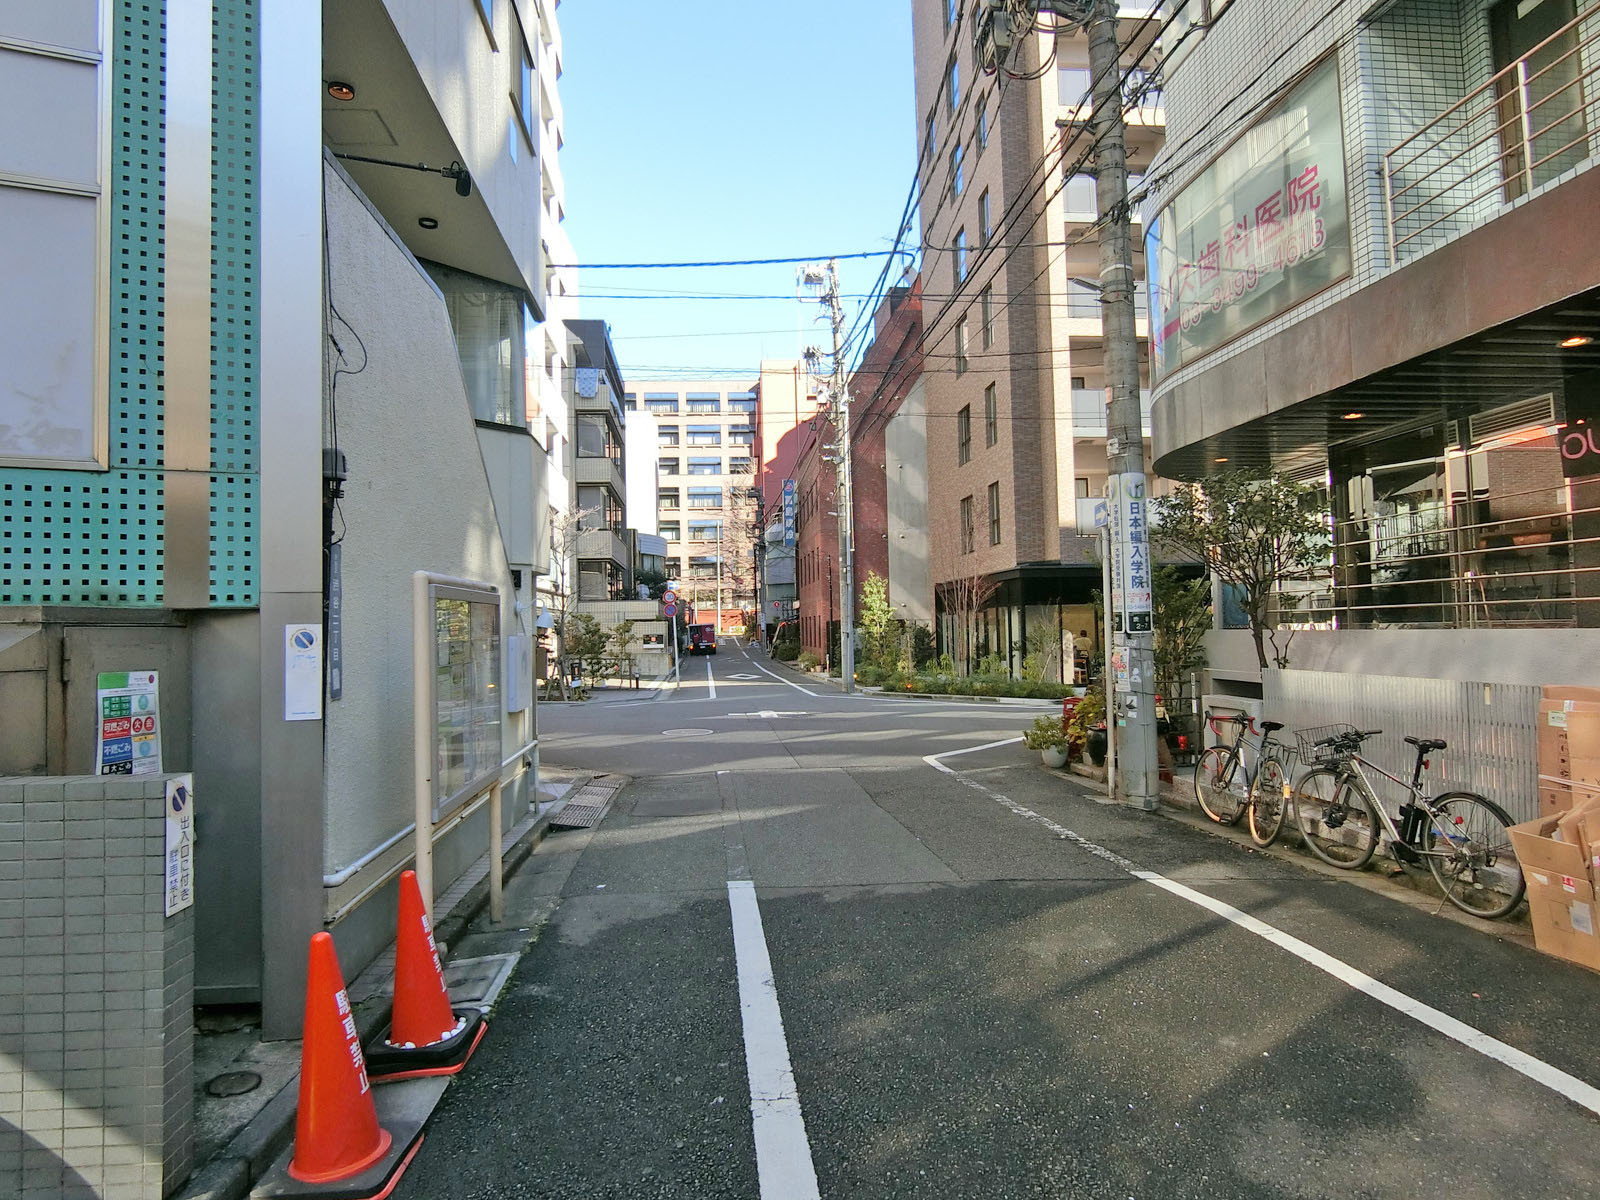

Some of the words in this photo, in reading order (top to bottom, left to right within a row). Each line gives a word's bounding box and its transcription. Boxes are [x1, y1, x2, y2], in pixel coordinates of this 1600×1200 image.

[1129, 502, 1145, 589] 日本編入学院
